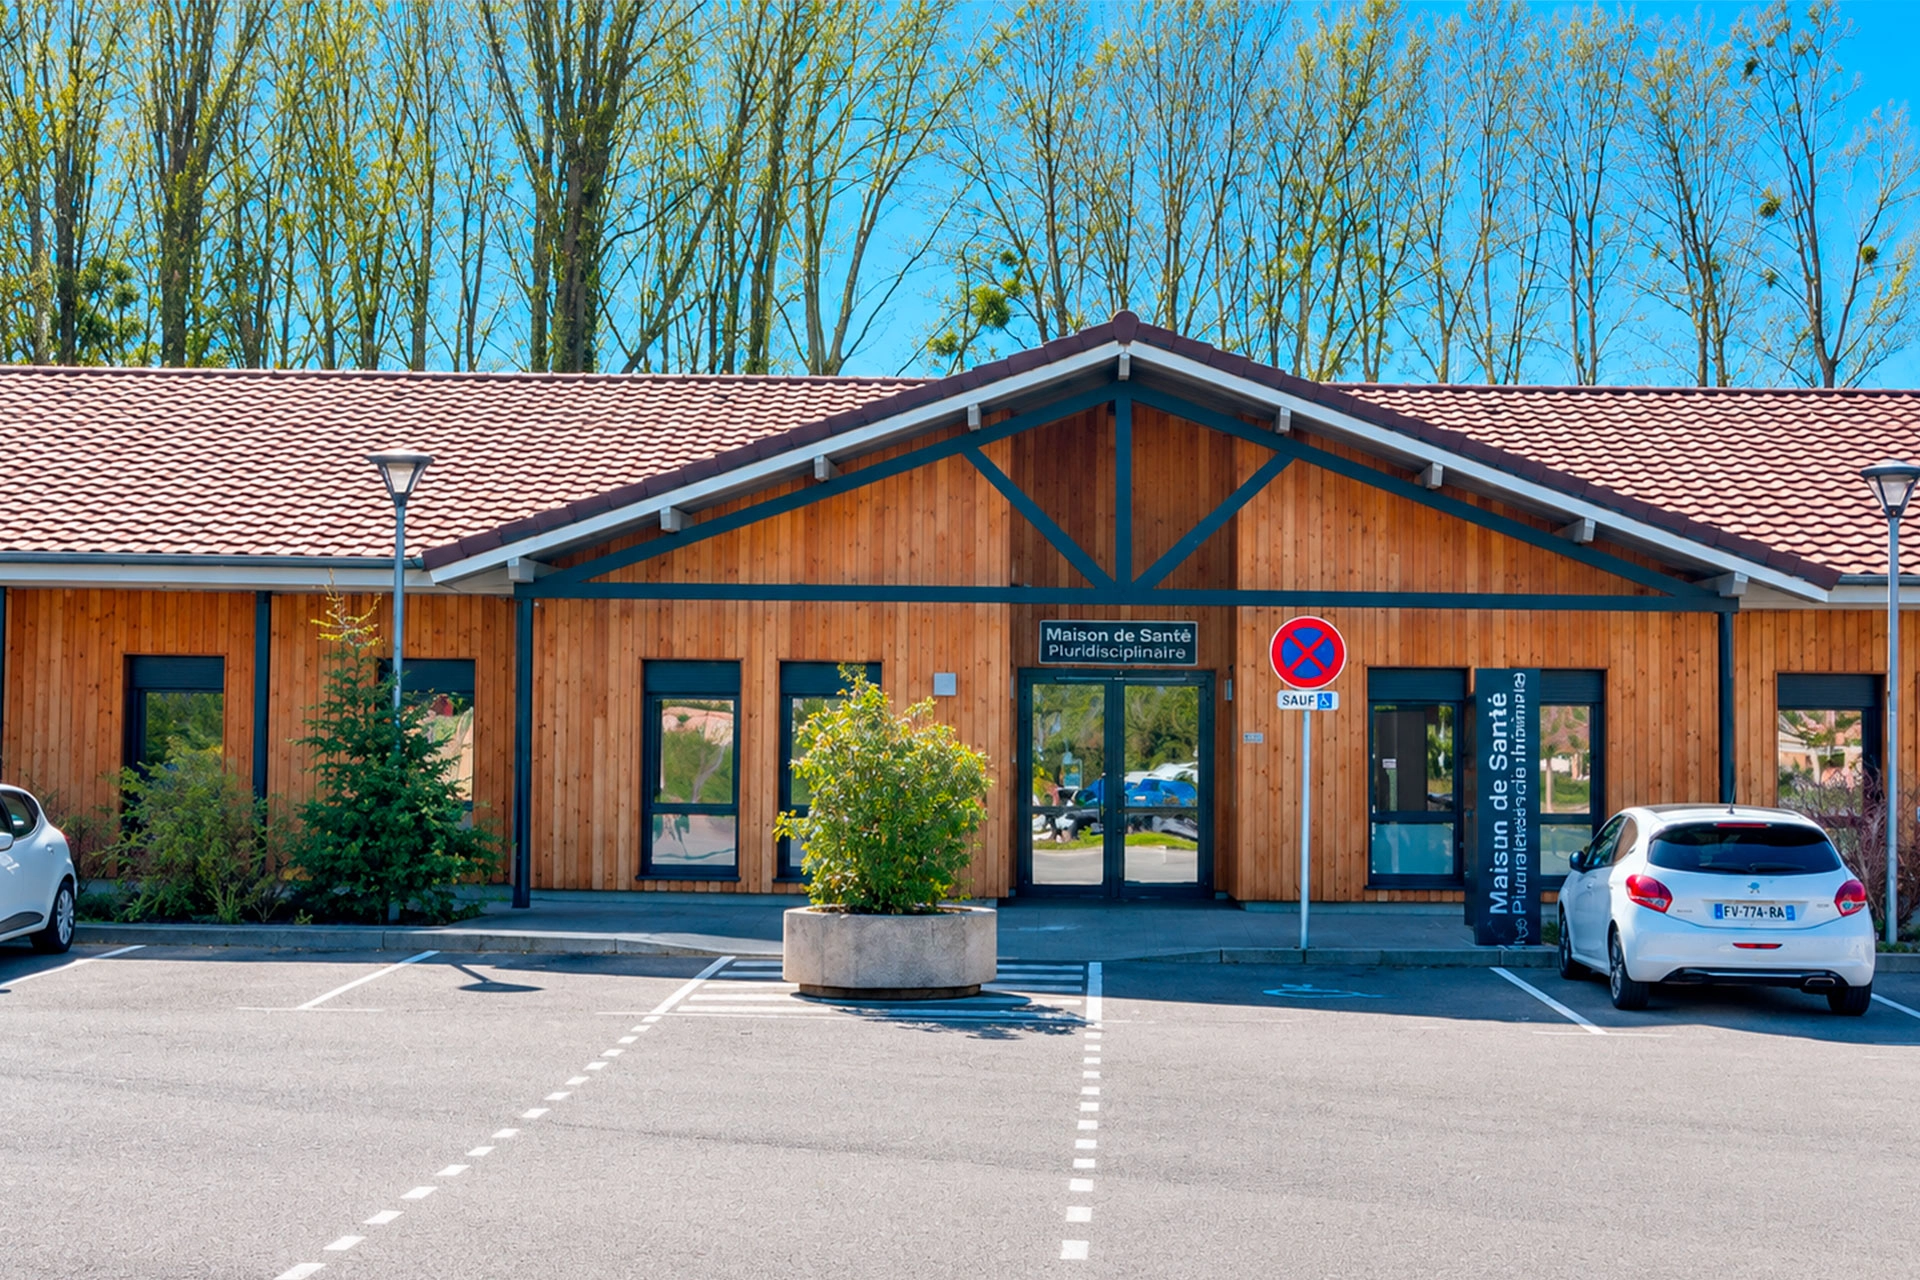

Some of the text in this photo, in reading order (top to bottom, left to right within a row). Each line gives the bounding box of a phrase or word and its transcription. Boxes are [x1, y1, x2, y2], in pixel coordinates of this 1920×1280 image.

[1046, 627, 1191, 643] Maison de Santé
[1049, 644, 1186, 661] Pluridisciplinaire
[1282, 694, 1315, 706] SAUF
[1489, 779, 1508, 811] de
